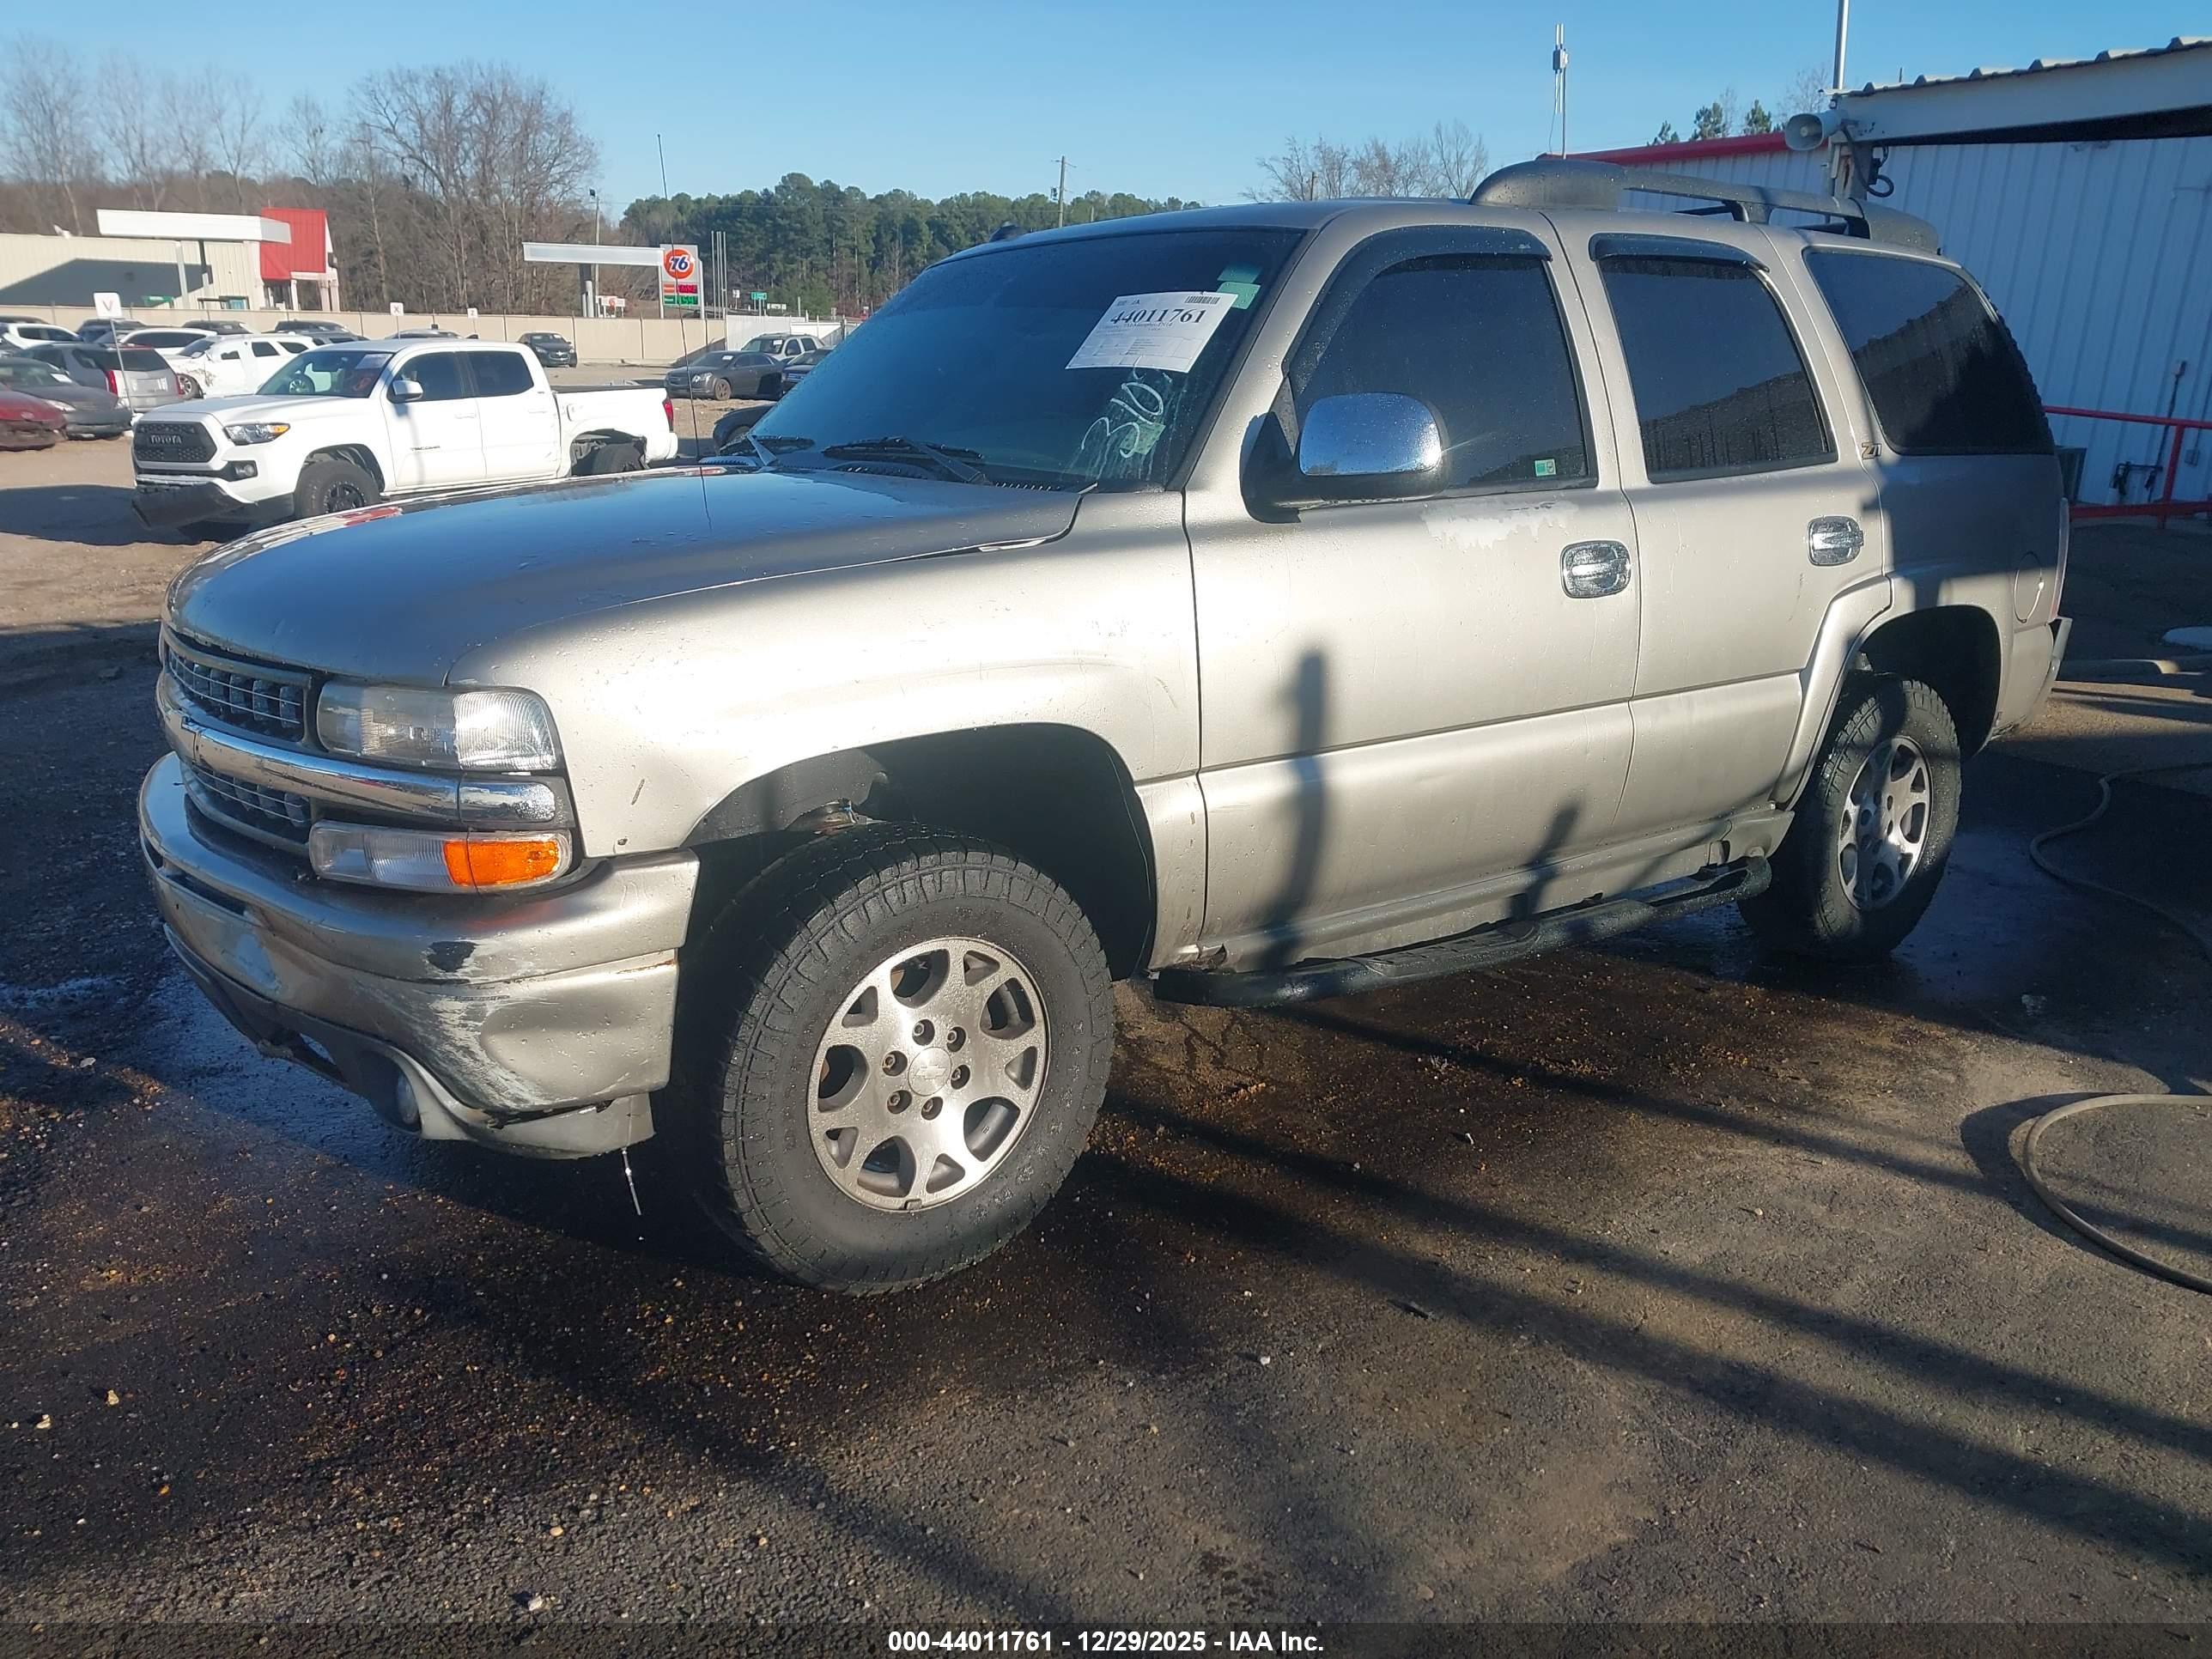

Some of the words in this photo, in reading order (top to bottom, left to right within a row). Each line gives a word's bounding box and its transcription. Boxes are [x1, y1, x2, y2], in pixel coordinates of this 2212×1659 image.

[670, 255, 689, 271] 76
[102, 300, 113, 311] V
[393, 305, 400, 313] X
[1111, 307, 1207, 325] 44011761
[150, 434, 183, 445] TOYOTA
